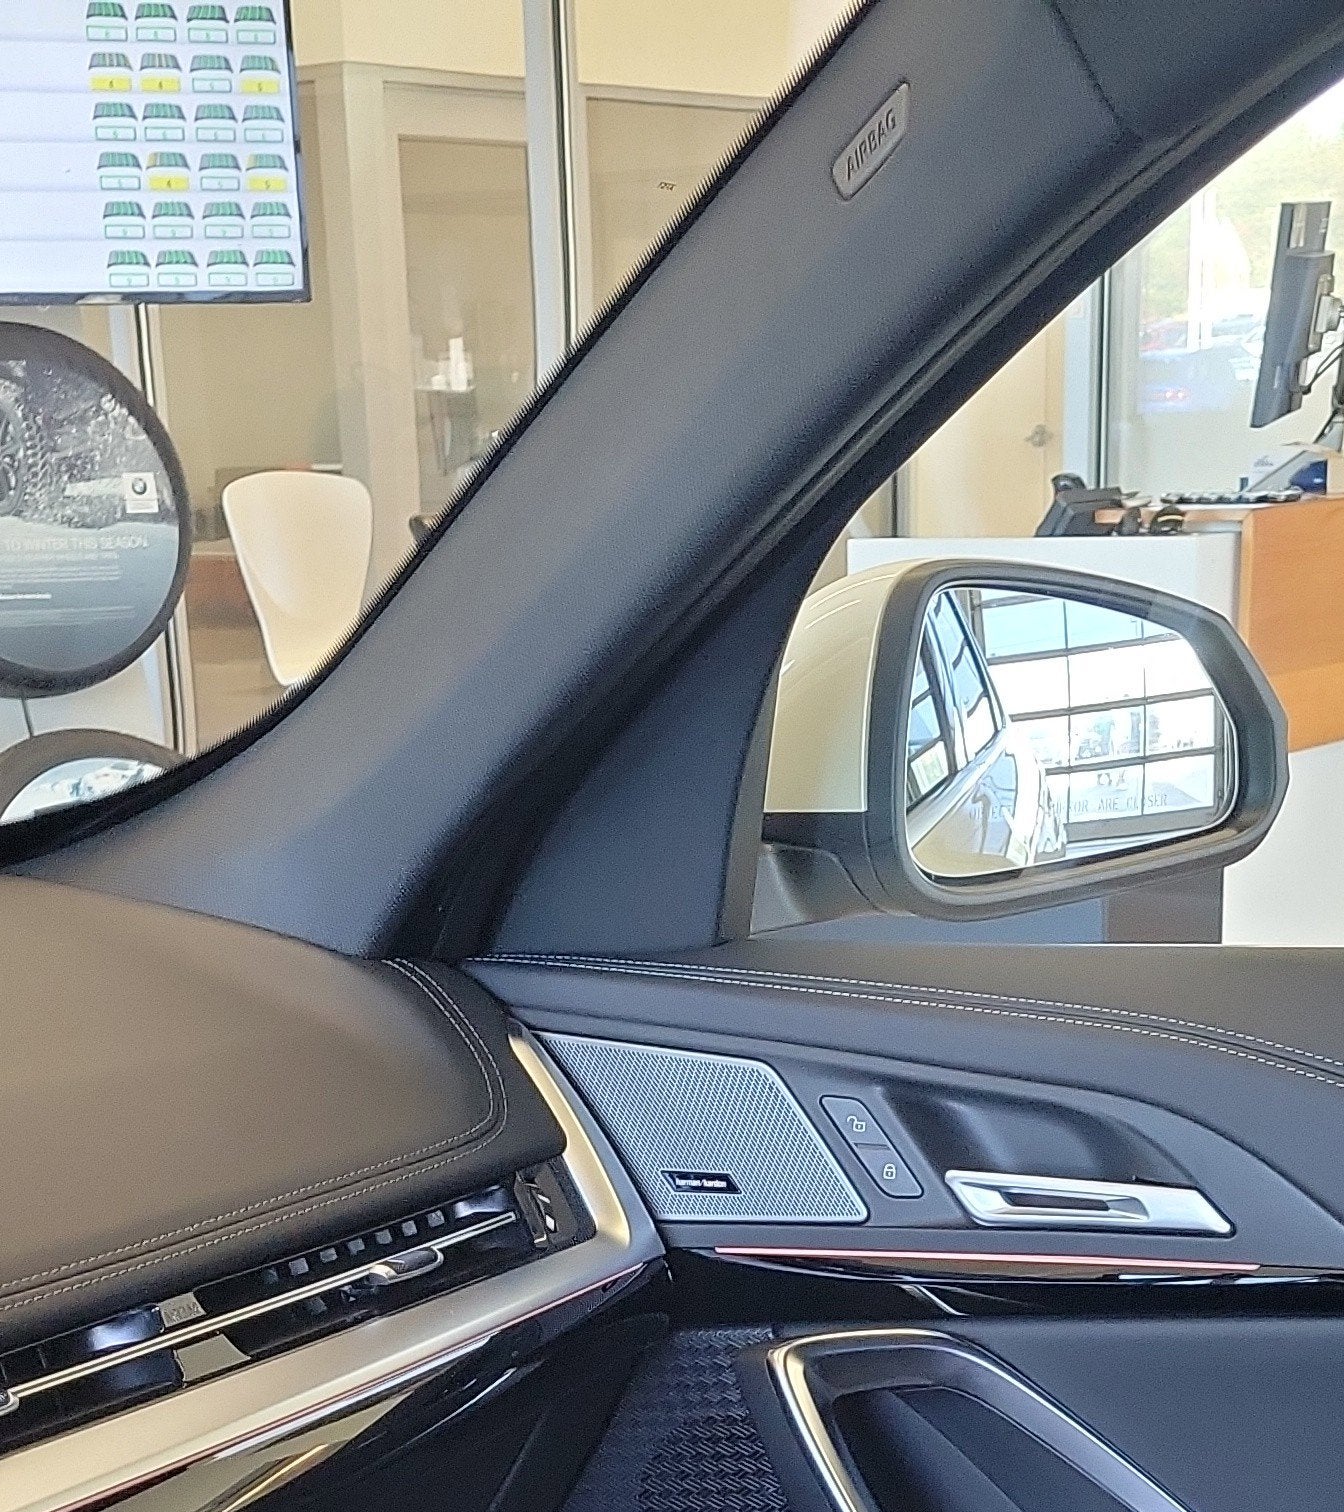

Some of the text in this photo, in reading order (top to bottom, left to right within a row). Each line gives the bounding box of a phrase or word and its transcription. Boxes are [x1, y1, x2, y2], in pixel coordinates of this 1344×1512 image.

[845, 108, 897, 181] AIRBAG
[1098, 796, 1119, 811] ARE
[1126, 794, 1168, 811] CLSER
